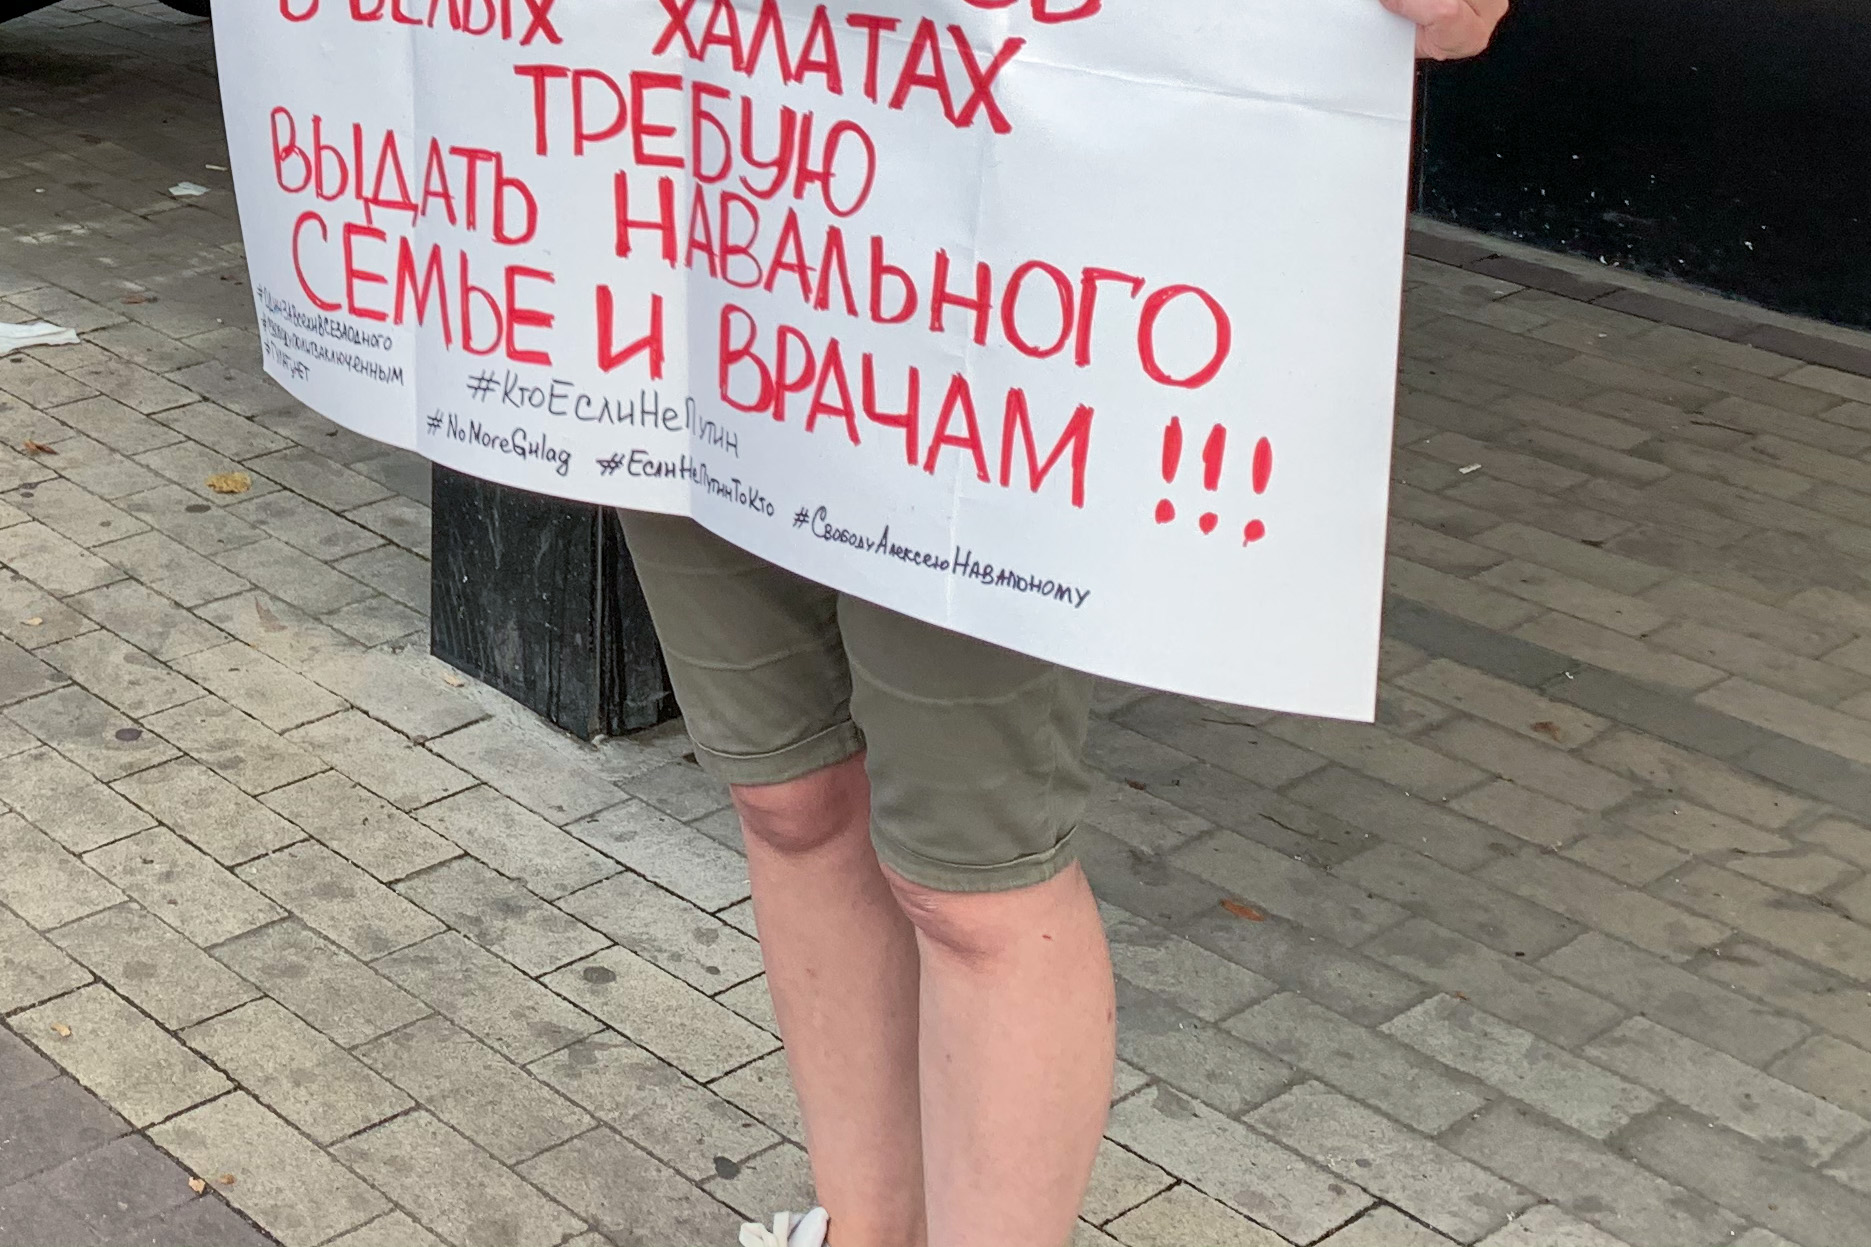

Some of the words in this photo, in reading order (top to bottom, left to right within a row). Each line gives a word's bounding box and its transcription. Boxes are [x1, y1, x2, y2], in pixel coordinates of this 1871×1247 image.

[270, 105, 538, 246] ВЫДАТЬ
[614, 169, 1232, 390] НАВАЛЬНОГО
[513, 63, 877, 217] ТРЕБУЮ
[292, 209, 556, 366] СЕМЬЕ
[596, 284, 666, 380] И
[719, 302, 1095, 509] ВРАЧАМ
